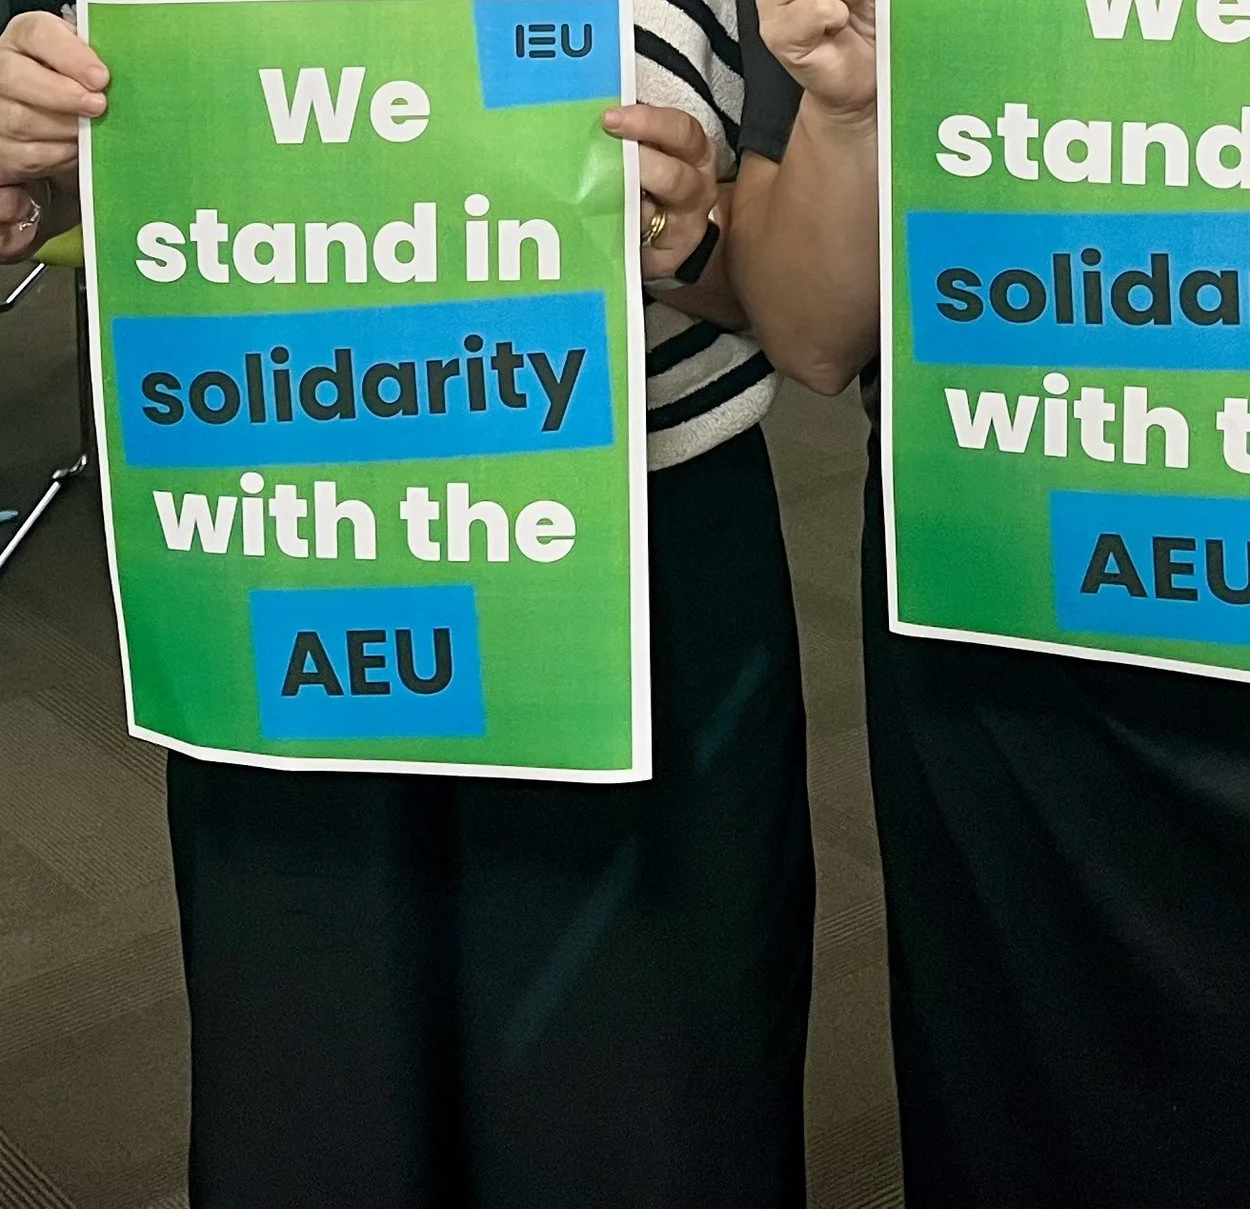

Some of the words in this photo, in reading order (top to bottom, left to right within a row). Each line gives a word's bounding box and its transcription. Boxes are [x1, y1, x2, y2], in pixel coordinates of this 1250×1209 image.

[515, 23, 595, 58] IEU
[259, 66, 431, 145] We
[135, 202, 435, 285] stand
[465, 194, 560, 282] in
[141, 333, 586, 432] solidarity
[944, 372, 1190, 470] with
[153, 472, 377, 560] with
[400, 482, 577, 564] the
[281, 628, 453, 697] AEU
